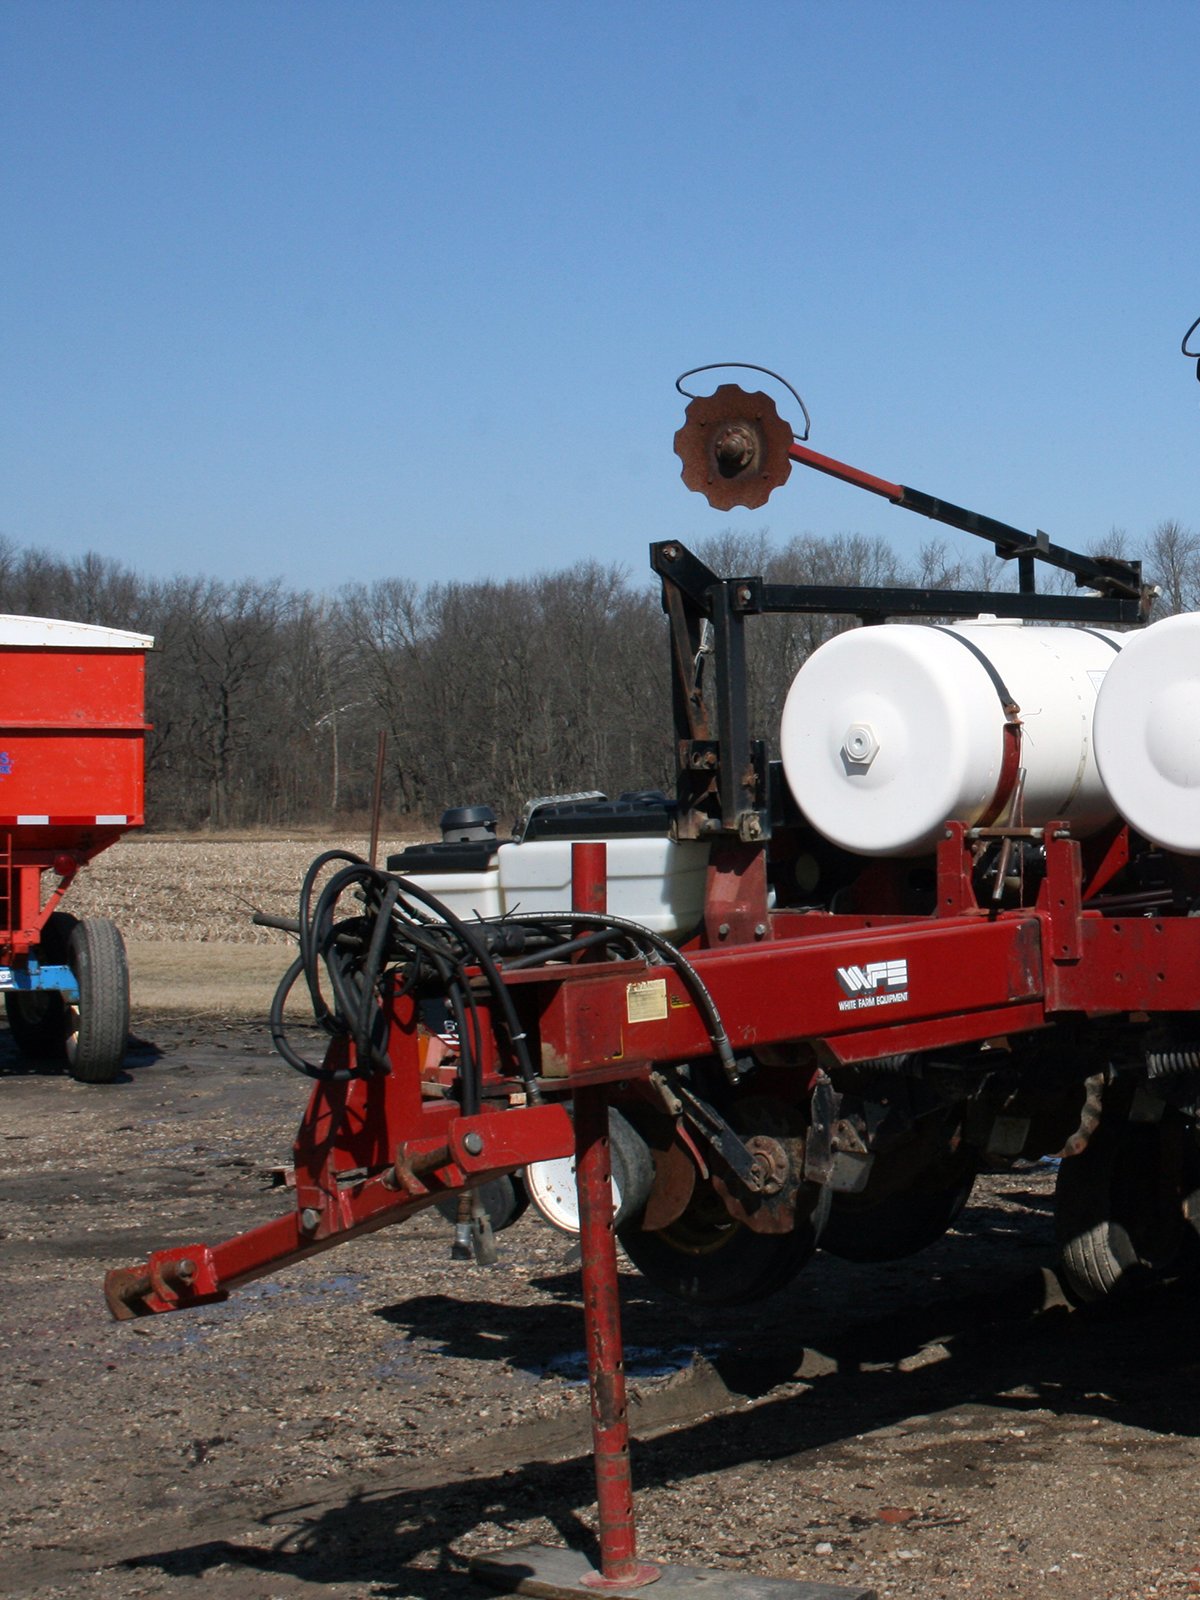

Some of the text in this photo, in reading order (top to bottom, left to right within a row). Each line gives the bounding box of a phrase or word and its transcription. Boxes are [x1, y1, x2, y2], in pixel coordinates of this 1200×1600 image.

[836, 959, 908, 993] WFE
[838, 991, 909, 1011] WHITE FARM EQUIPMENT
